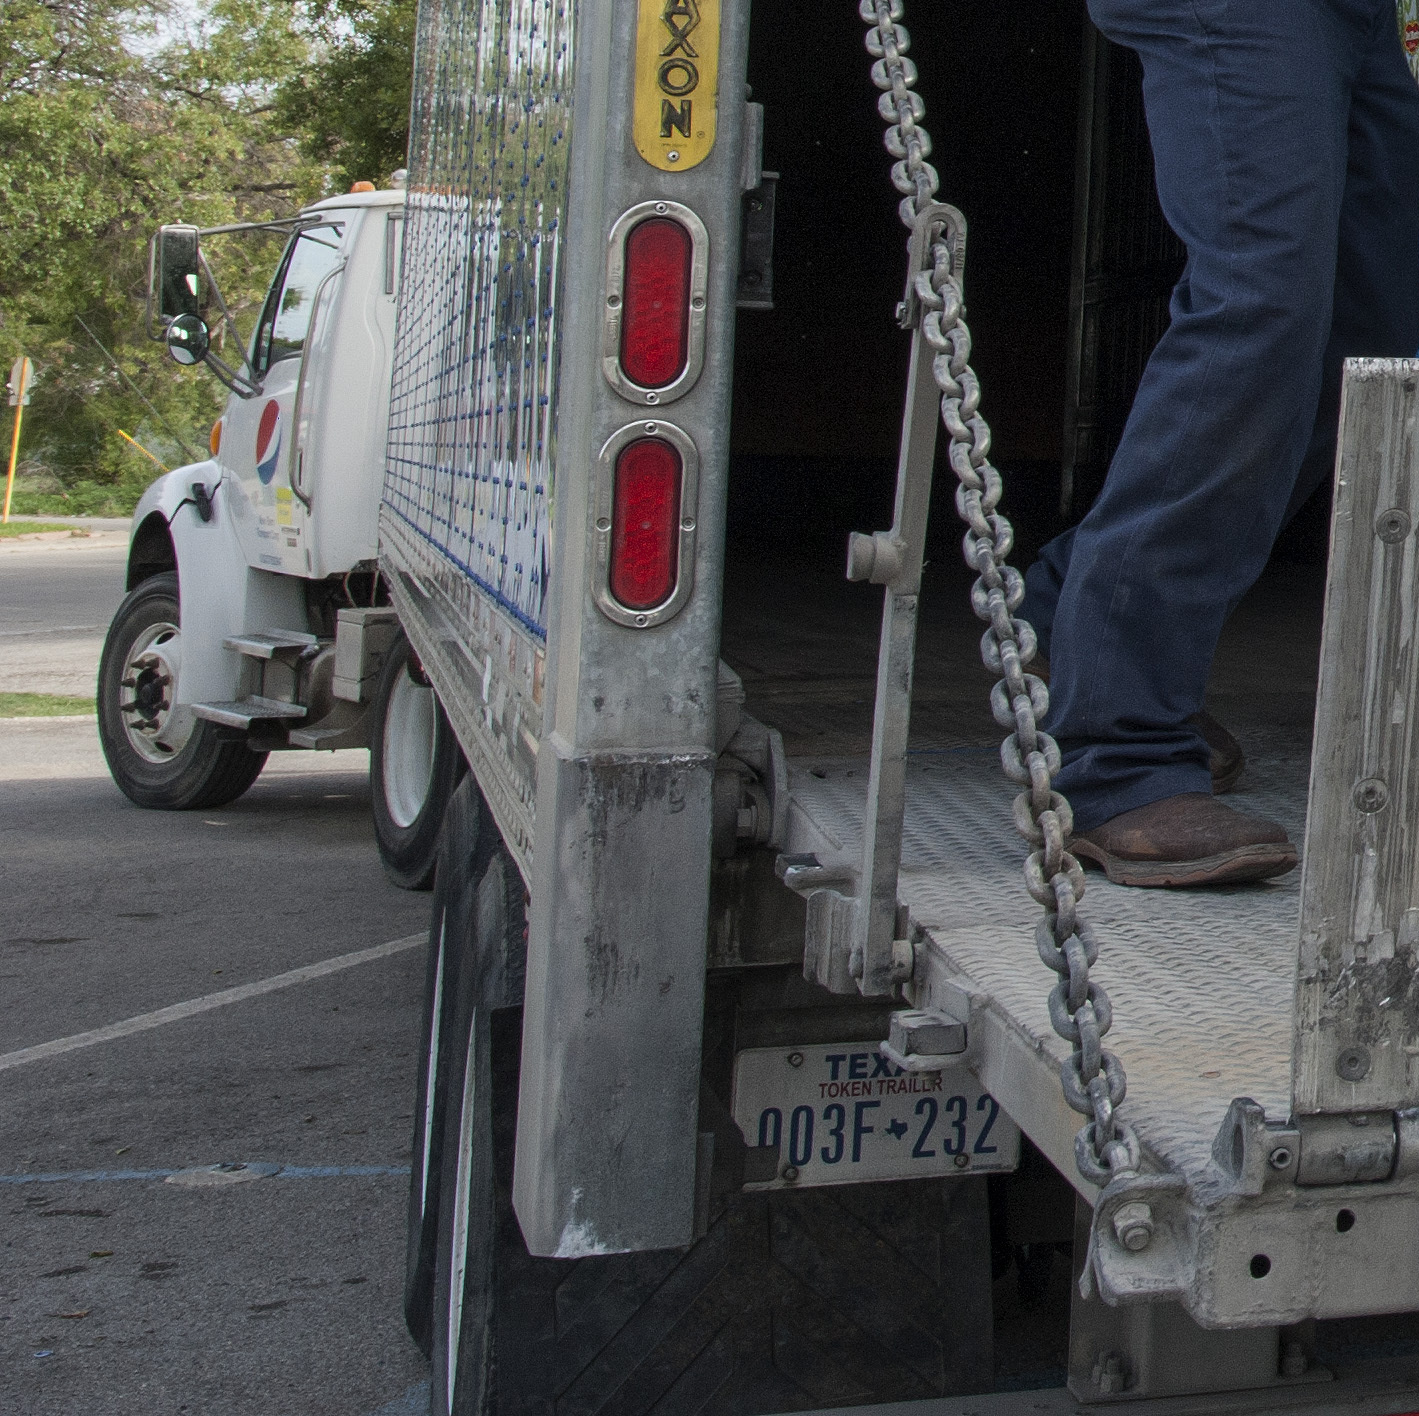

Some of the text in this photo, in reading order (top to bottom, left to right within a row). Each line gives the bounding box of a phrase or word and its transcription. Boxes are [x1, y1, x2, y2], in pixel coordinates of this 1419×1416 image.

[818, 1082, 872, 1098] TOKEN
[758, 1093, 1000, 1166] 003F 232
